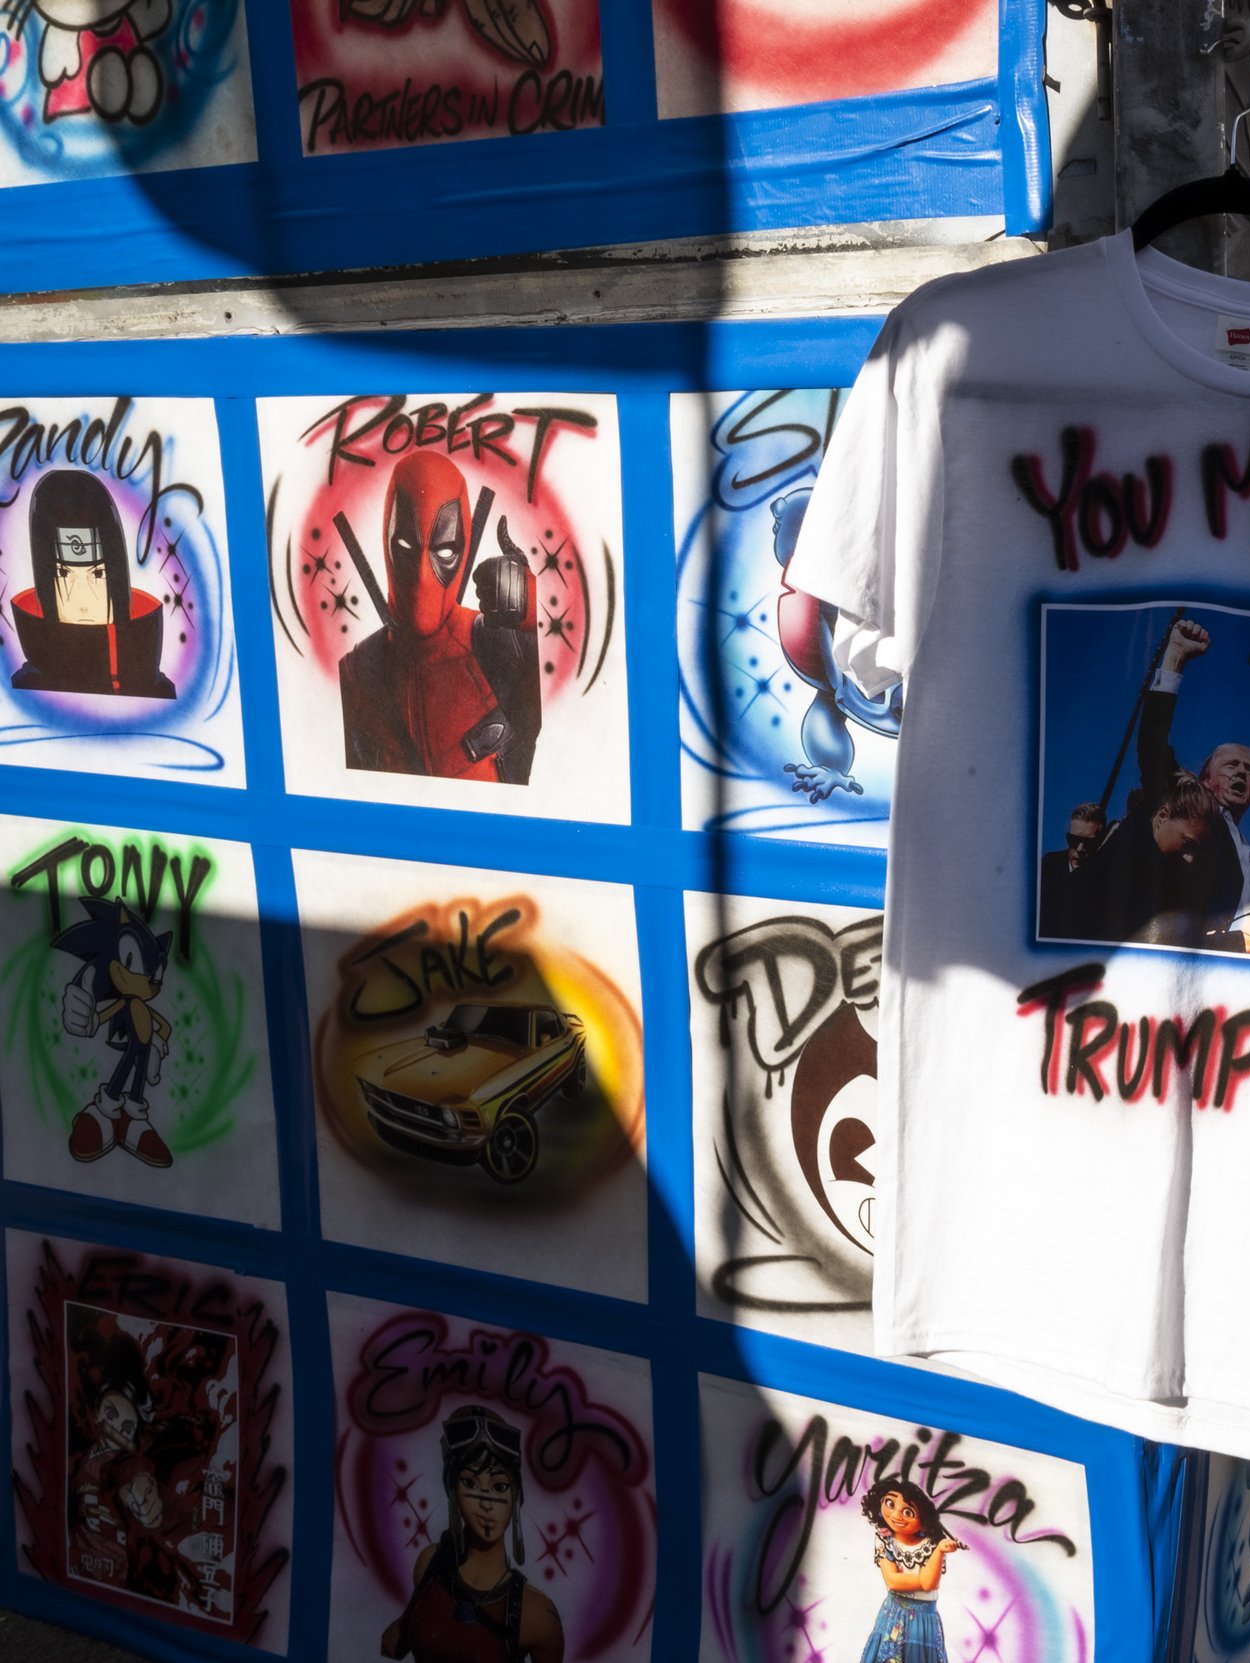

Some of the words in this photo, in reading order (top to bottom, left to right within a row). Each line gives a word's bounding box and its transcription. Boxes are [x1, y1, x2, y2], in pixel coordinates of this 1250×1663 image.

[298, 77, 461, 153] PARTNERS
[467, 75, 500, 128] IN
[299, 393, 597, 504] ROBERT
[1011, 424, 1173, 572] YOU
[13, 836, 211, 963] TONY
[351, 908, 522, 1020] JAKE
[77, 1254, 235, 1326] ERIC
[365, 1329, 631, 1472] Emily
[755, 1414, 1075, 1615] Yaritza
